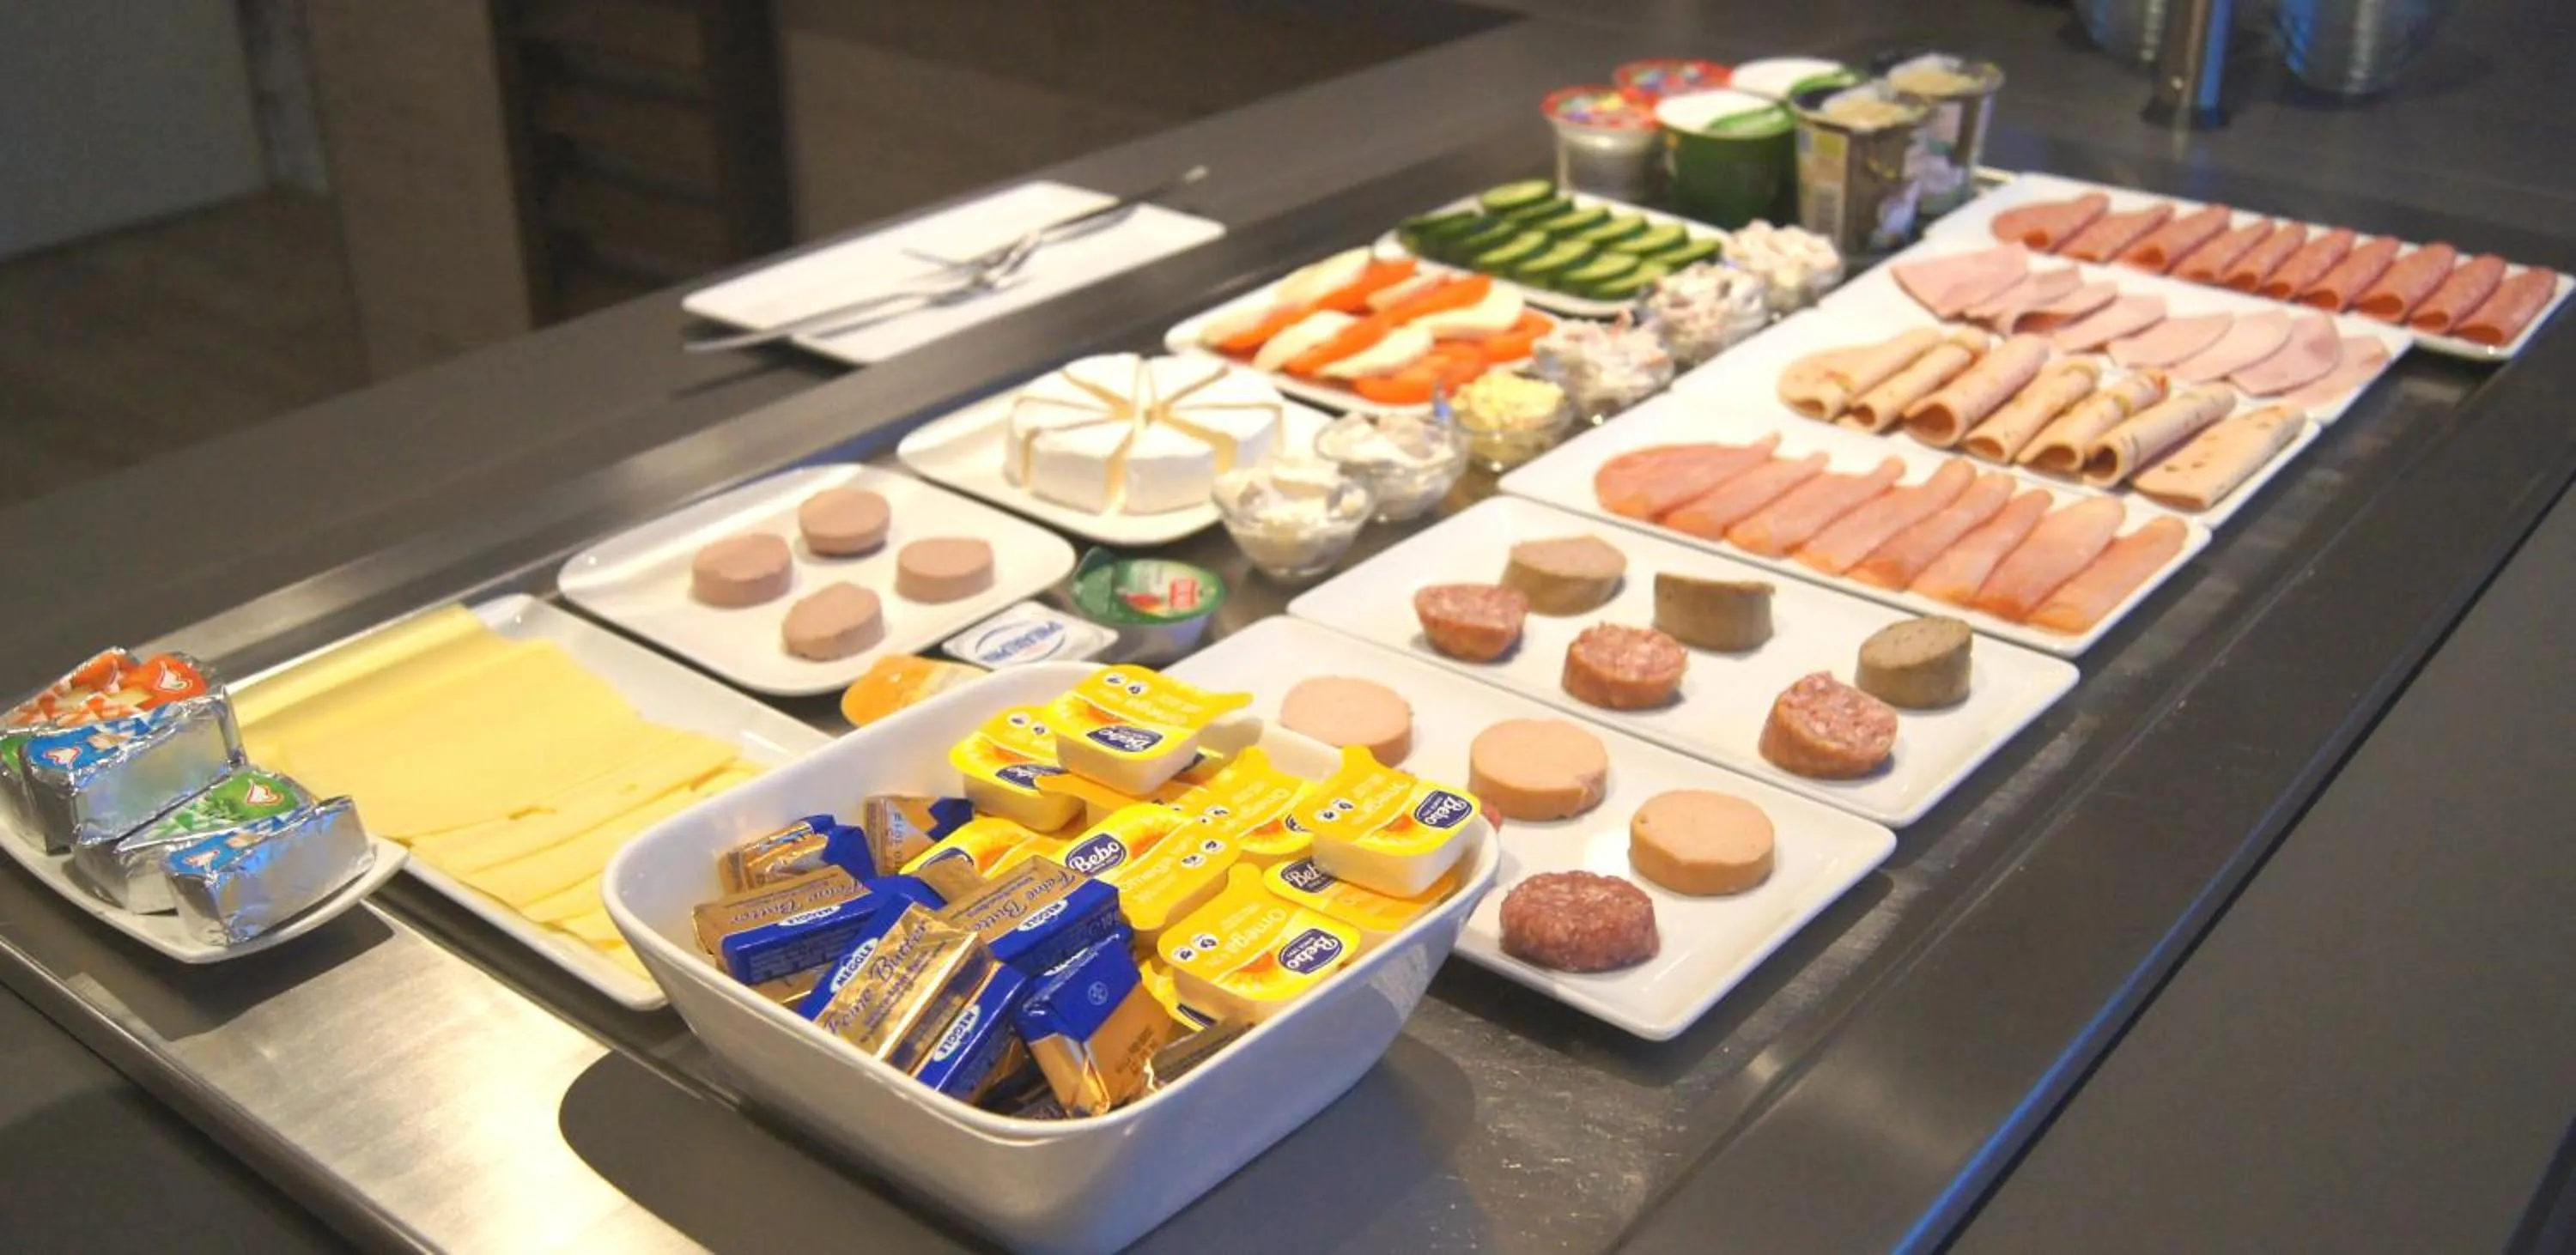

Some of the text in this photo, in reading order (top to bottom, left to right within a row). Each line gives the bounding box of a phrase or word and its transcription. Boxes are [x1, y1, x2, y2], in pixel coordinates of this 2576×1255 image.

[1425, 795, 1468, 826] Bebo
[1069, 840, 1121, 873] Bebo
[971, 899, 1028, 932] Butte
[836, 944, 874, 987] MEGGLE
[1286, 935, 1340, 970] Bebo
[937, 1011, 976, 1054] MEGGLE
